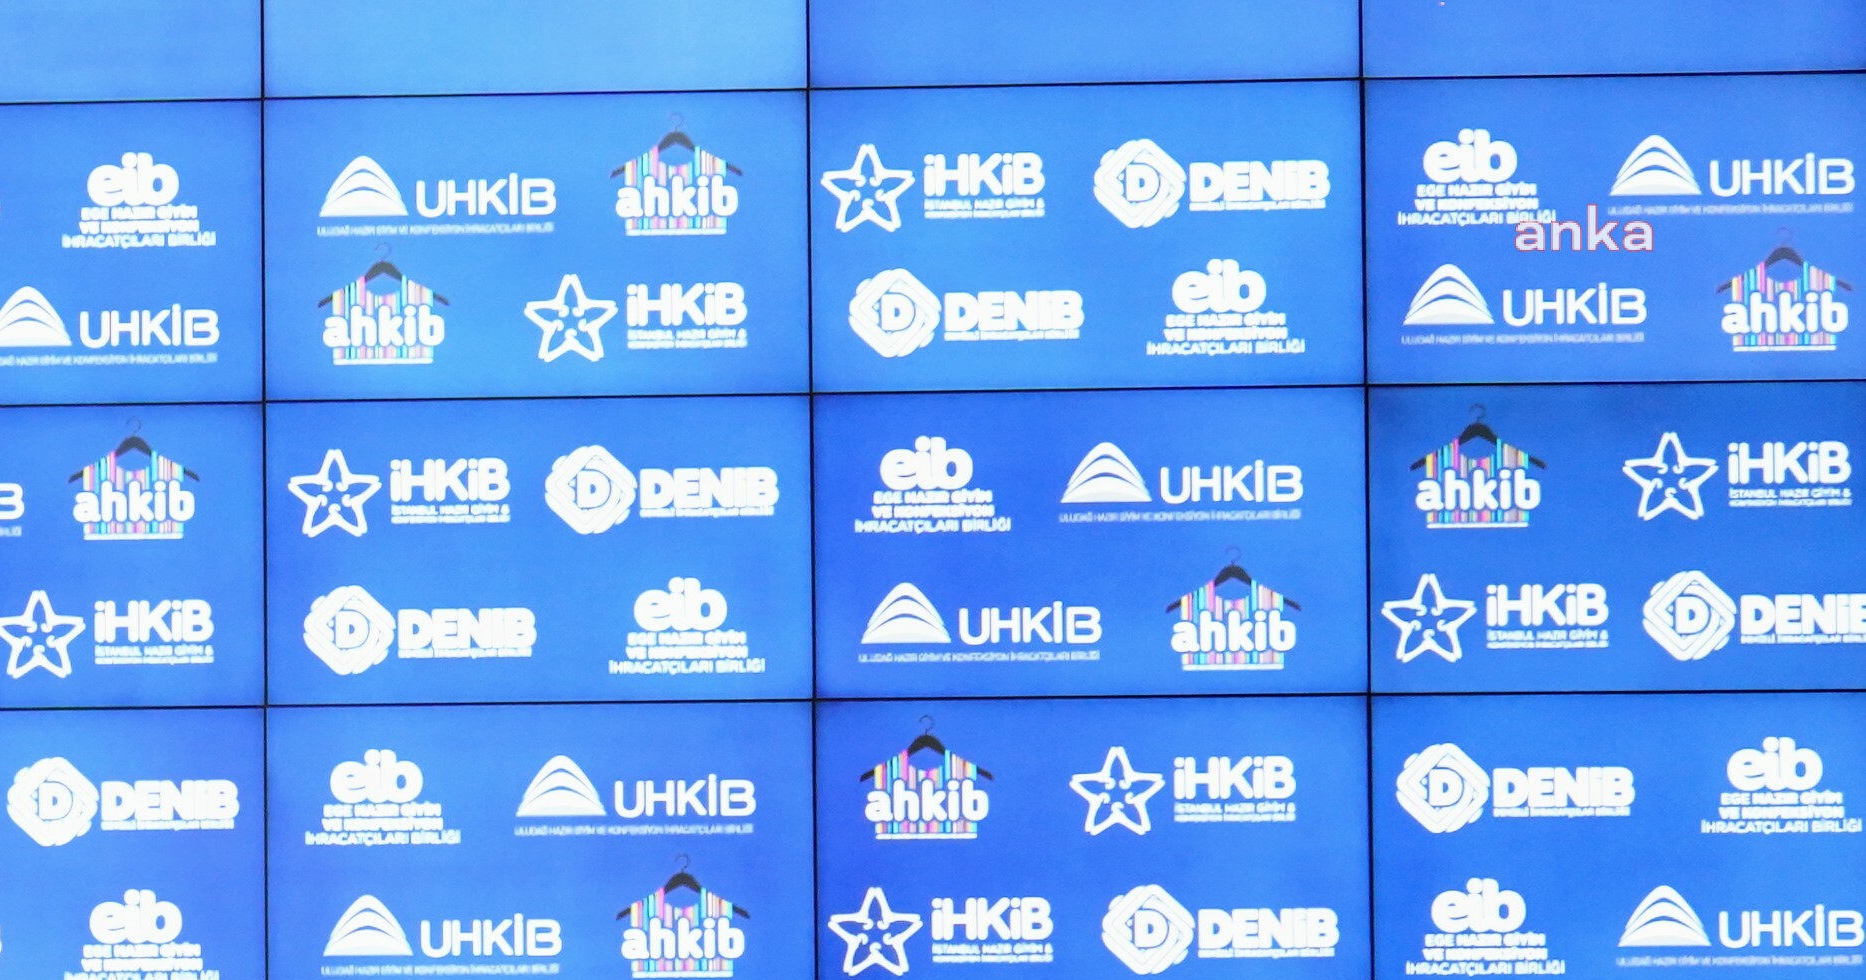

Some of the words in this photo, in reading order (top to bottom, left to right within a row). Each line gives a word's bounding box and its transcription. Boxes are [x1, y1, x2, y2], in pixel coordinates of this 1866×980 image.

[1423, 129, 1517, 182] eib
[1710, 153, 1854, 196] UHKİB
[87, 153, 180, 206] eib
[416, 173, 556, 217] UHKİB
[616, 174, 737, 218] ahkib
[1172, 259, 1266, 313] eib
[1503, 283, 1646, 326] UHKİB
[80, 304, 219, 348] UHKİB
[323, 303, 444, 347] ahkib
[1722, 290, 1847, 335] ahkib
[880, 436, 973, 490] eib
[1160, 460, 1303, 504] UHKİB
[74, 479, 194, 523] ahkib
[1416, 468, 1540, 512] ahkib
[634, 577, 727, 631] eib
[959, 601, 1102, 645] UHKİB
[1172, 609, 1295, 654] ahkib
[330, 749, 422, 804] eib
[1727, 737, 1823, 792] eib
[615, 774, 756, 818] UHKİB
[865, 778, 988, 822] ahkib
[90, 889, 182, 943] eib
[1431, 878, 1526, 932] eib
[1719, 905, 1864, 948] UHKİB
[421, 914, 562, 957] UHKİB
[622, 916, 744, 961] ahkib
